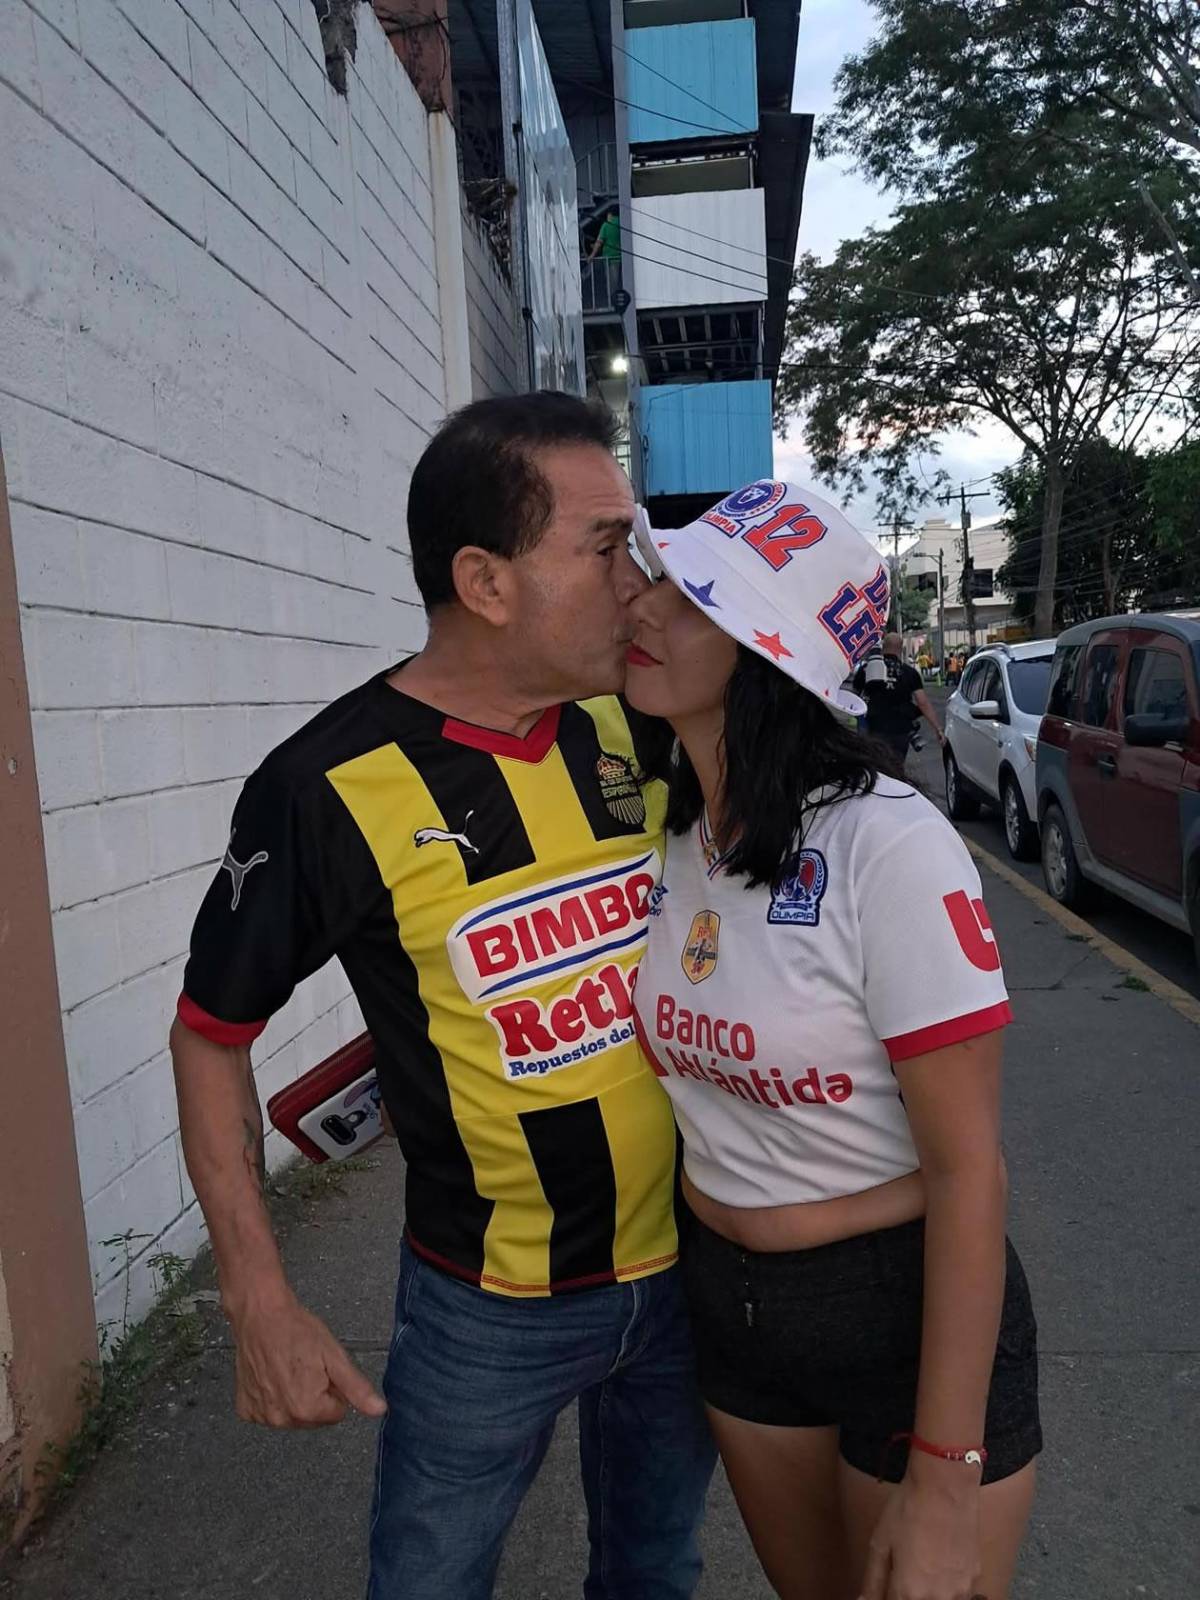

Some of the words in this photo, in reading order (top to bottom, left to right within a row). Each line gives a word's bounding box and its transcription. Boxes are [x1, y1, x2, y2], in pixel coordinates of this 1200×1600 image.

[742, 504, 828, 571] 12
[465, 872, 655, 978] BIMBO
[771, 910, 815, 921] OLIMPIA
[508, 1037, 608, 1077] Repuestos
[609, 1021, 635, 1044] del
[656, 994, 756, 1062] Banco
[665, 1046, 854, 1109] Atlántida
